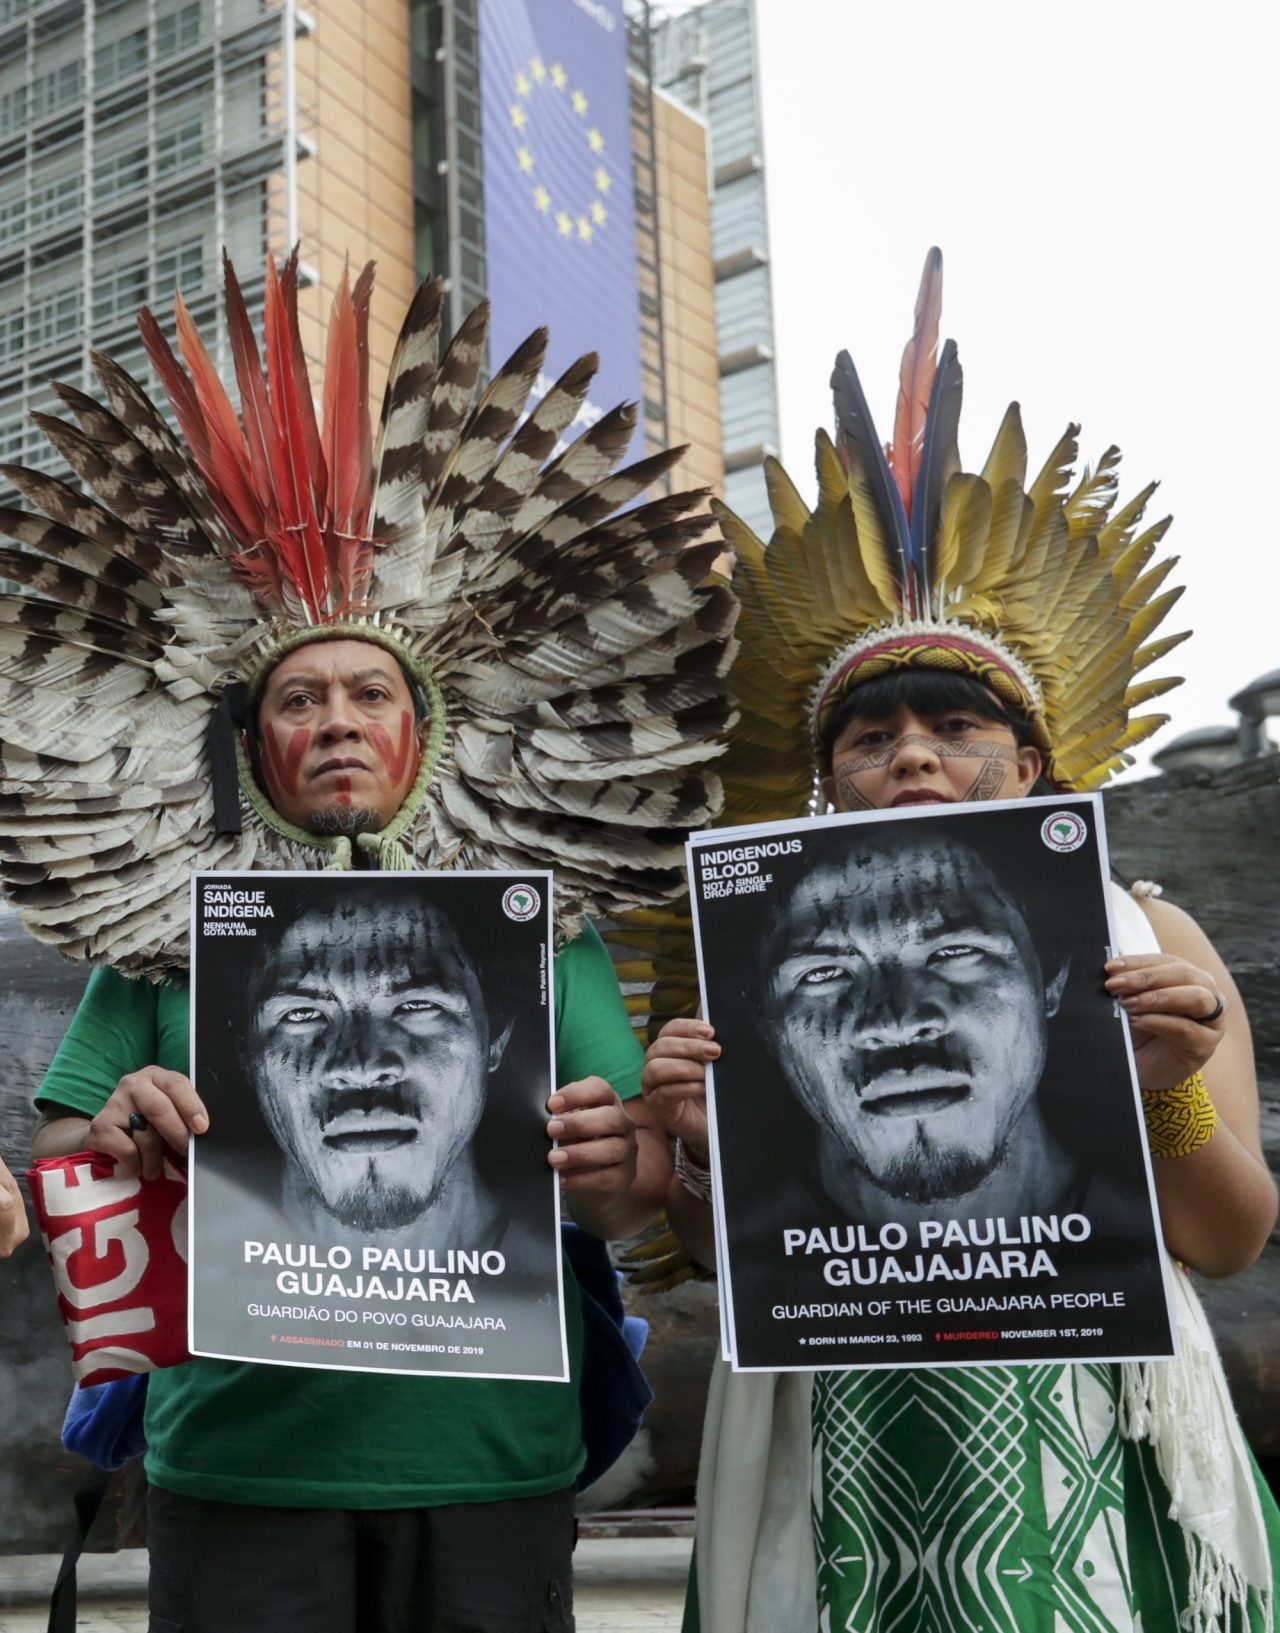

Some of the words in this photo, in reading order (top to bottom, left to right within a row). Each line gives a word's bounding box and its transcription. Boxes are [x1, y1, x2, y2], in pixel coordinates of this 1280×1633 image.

[700, 839, 802, 866] INDIGENOUS
[701, 861, 760, 881] BLOOD
[703, 881, 724, 892] NOT
[726, 880, 734, 888] A
[736, 874, 773, 887] SINGLE
[704, 888, 733, 900] DROP
[735, 883, 766, 895] MORE
[204, 891, 265, 904] SANGUE
[204, 902, 274, 918] INDÍGENA
[203, 922, 246, 930] NENHUMA
[203, 928, 226, 936] GOTA
[228, 928, 234, 936] A
[236, 928, 257, 936] MAIS
[783, 1223, 908, 1256] PAULO
[919, 1213, 1092, 1248] PAULINO
[244, 1241, 352, 1269] PAULO
[362, 1247, 506, 1275] PAULINO
[823, 1249, 1058, 1286] GUAJAJARA
[276, 1271, 476, 1303] GUAJAJARA
[772, 1302, 863, 1319] GUARDIAN
[867, 1301, 891, 1316] OF
[896, 1299, 932, 1315] THE
[936, 1295, 1046, 1313] GUAJAJARA
[1050, 1292, 1126, 1309] PEOPLE
[247, 1303, 330, 1321] GUARDIÃO
[334, 1309, 358, 1323] DO
[362, 1311, 407, 1326] POVO
[411, 1314, 507, 1331] GUAJAJARA
[809, 1337, 836, 1345] BORN
[838, 1336, 848, 1344] IN
[850, 1335, 884, 1344] MARCH
[886, 1334, 900, 1343] 23,
[901, 1334, 922, 1342] 1993
[944, 1331, 999, 1340] MURDERED
[1001, 1329, 1057, 1339] NOVEMBER
[1059, 1329, 1079, 1338] 1ST,
[1080, 1328, 1104, 1336] 2019
[279, 1335, 345, 1347] ASSASSINADO
[347, 1340, 361, 1349] EM
[363, 1342, 373, 1350] 01
[376, 1342, 389, 1350] DE
[391, 1343, 445, 1353] NOVEMBRO
[447, 1346, 461, 1354] DE
[462, 1347, 484, 1355] 2019
